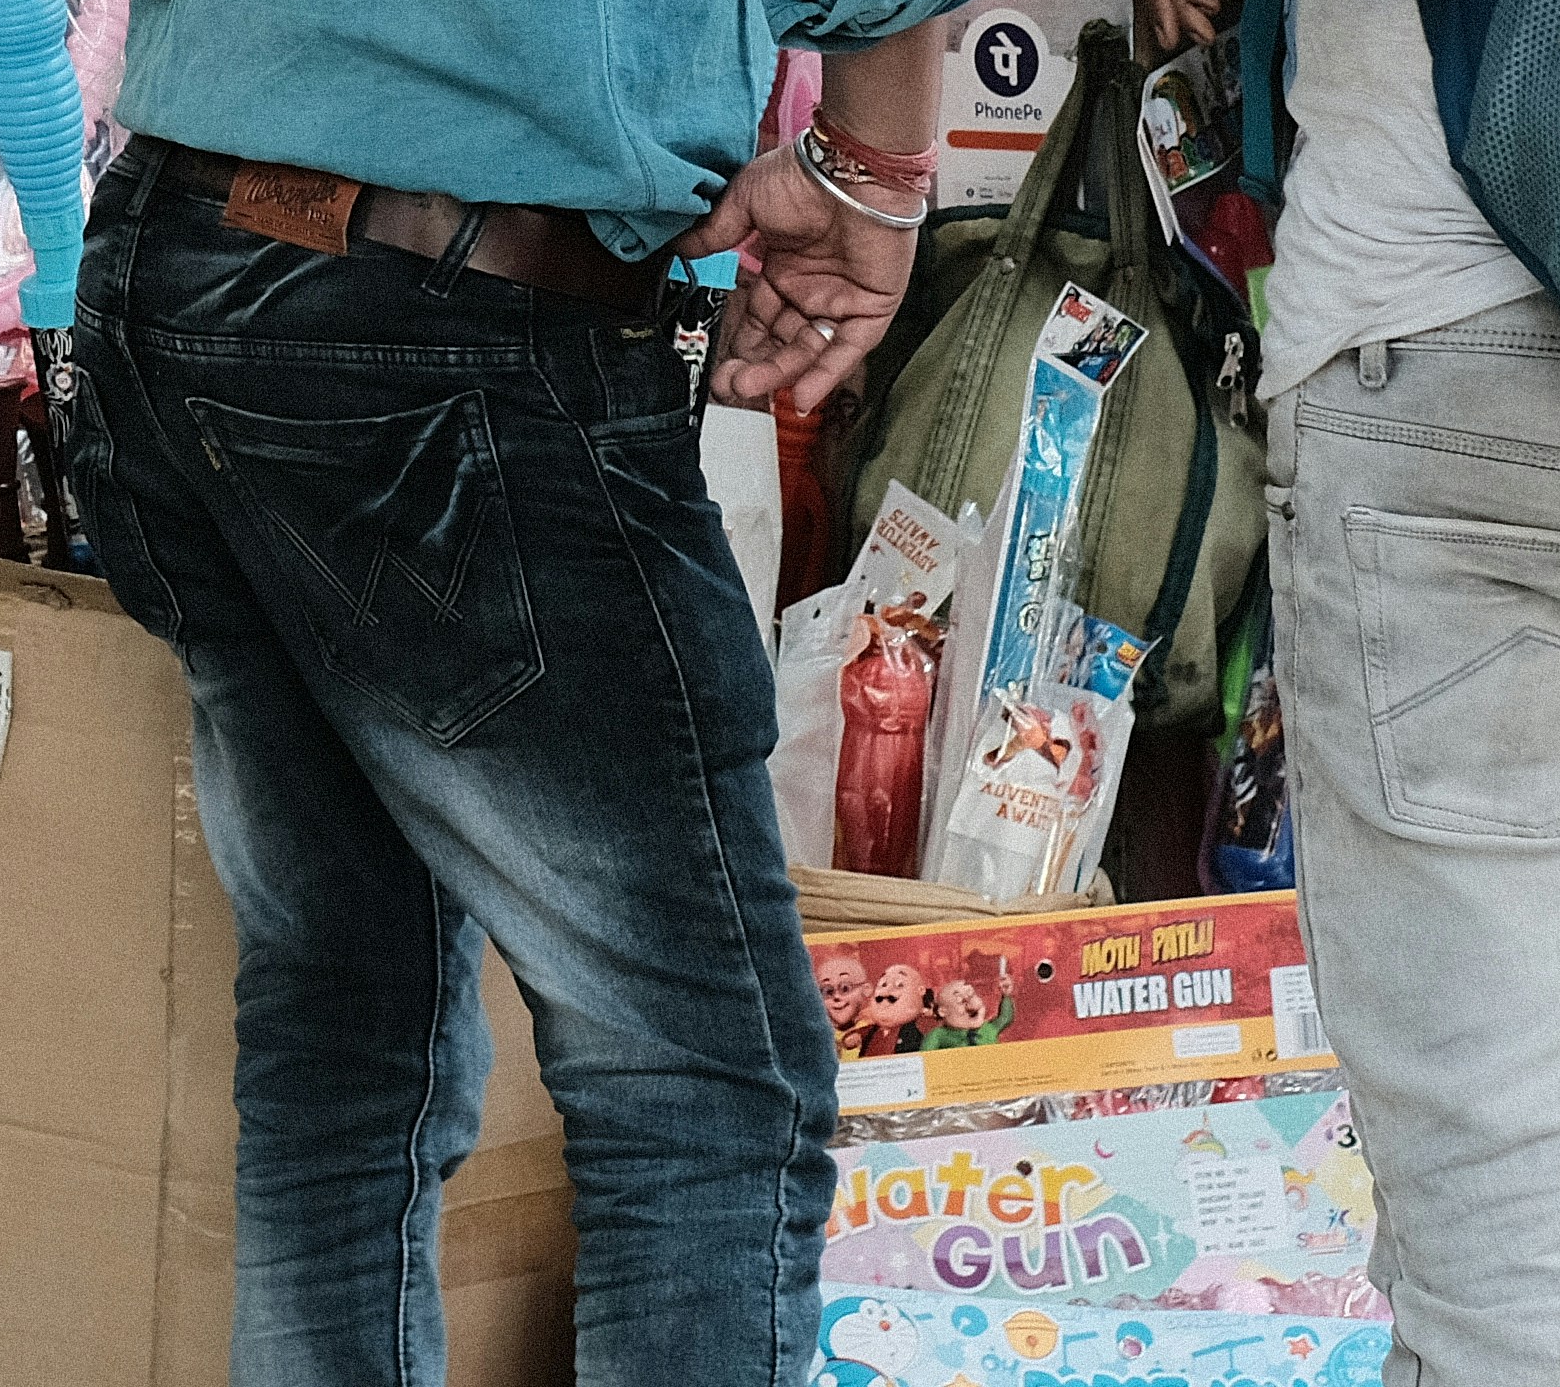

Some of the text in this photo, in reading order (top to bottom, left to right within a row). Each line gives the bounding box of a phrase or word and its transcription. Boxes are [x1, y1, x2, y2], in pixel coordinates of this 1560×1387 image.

[991, 33, 1022, 86] पे
[975, 101, 1043, 121] PhonePe
[1080, 917, 1216, 976] MOTU PATLU
[1073, 968, 1234, 1019] WATER GUN
[934, 1205, 1148, 1291] Gun
